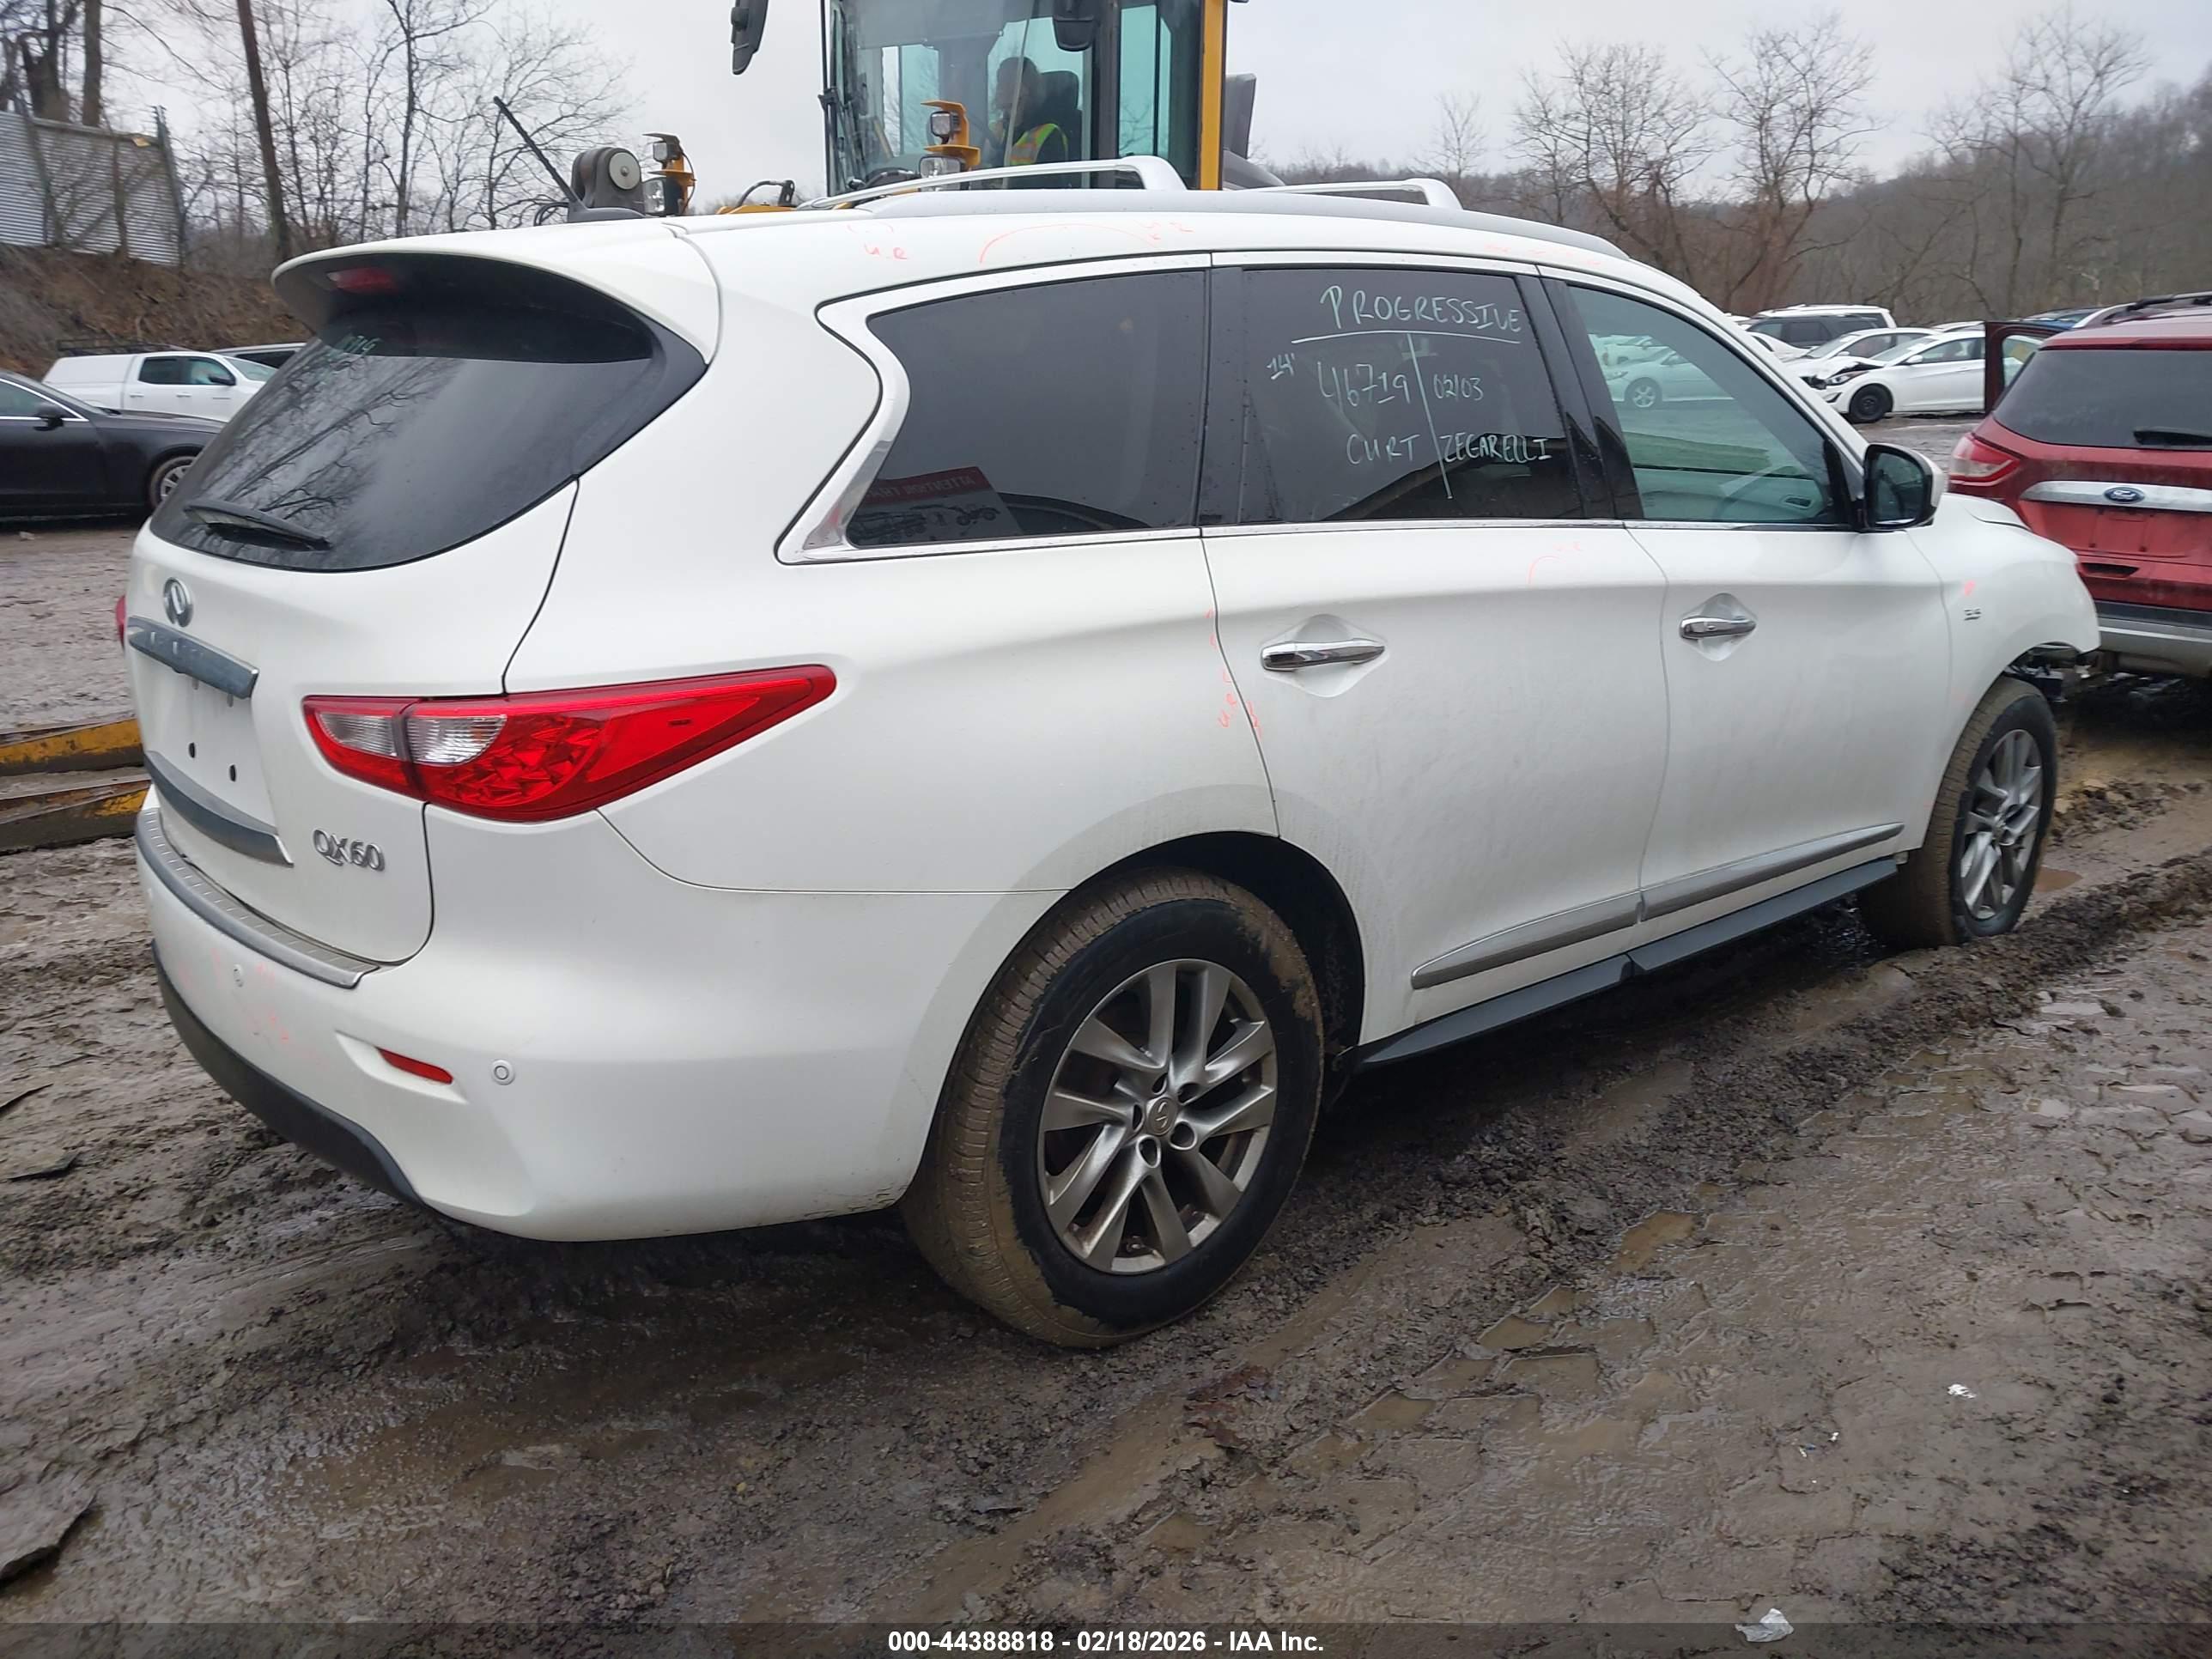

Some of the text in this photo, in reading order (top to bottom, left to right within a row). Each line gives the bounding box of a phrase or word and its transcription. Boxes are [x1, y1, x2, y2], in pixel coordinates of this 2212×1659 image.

[1320, 285, 1522, 332] PROGRESSIVE
[1346, 434, 1420, 465] CURT
[313, 829, 386, 872] QX60
